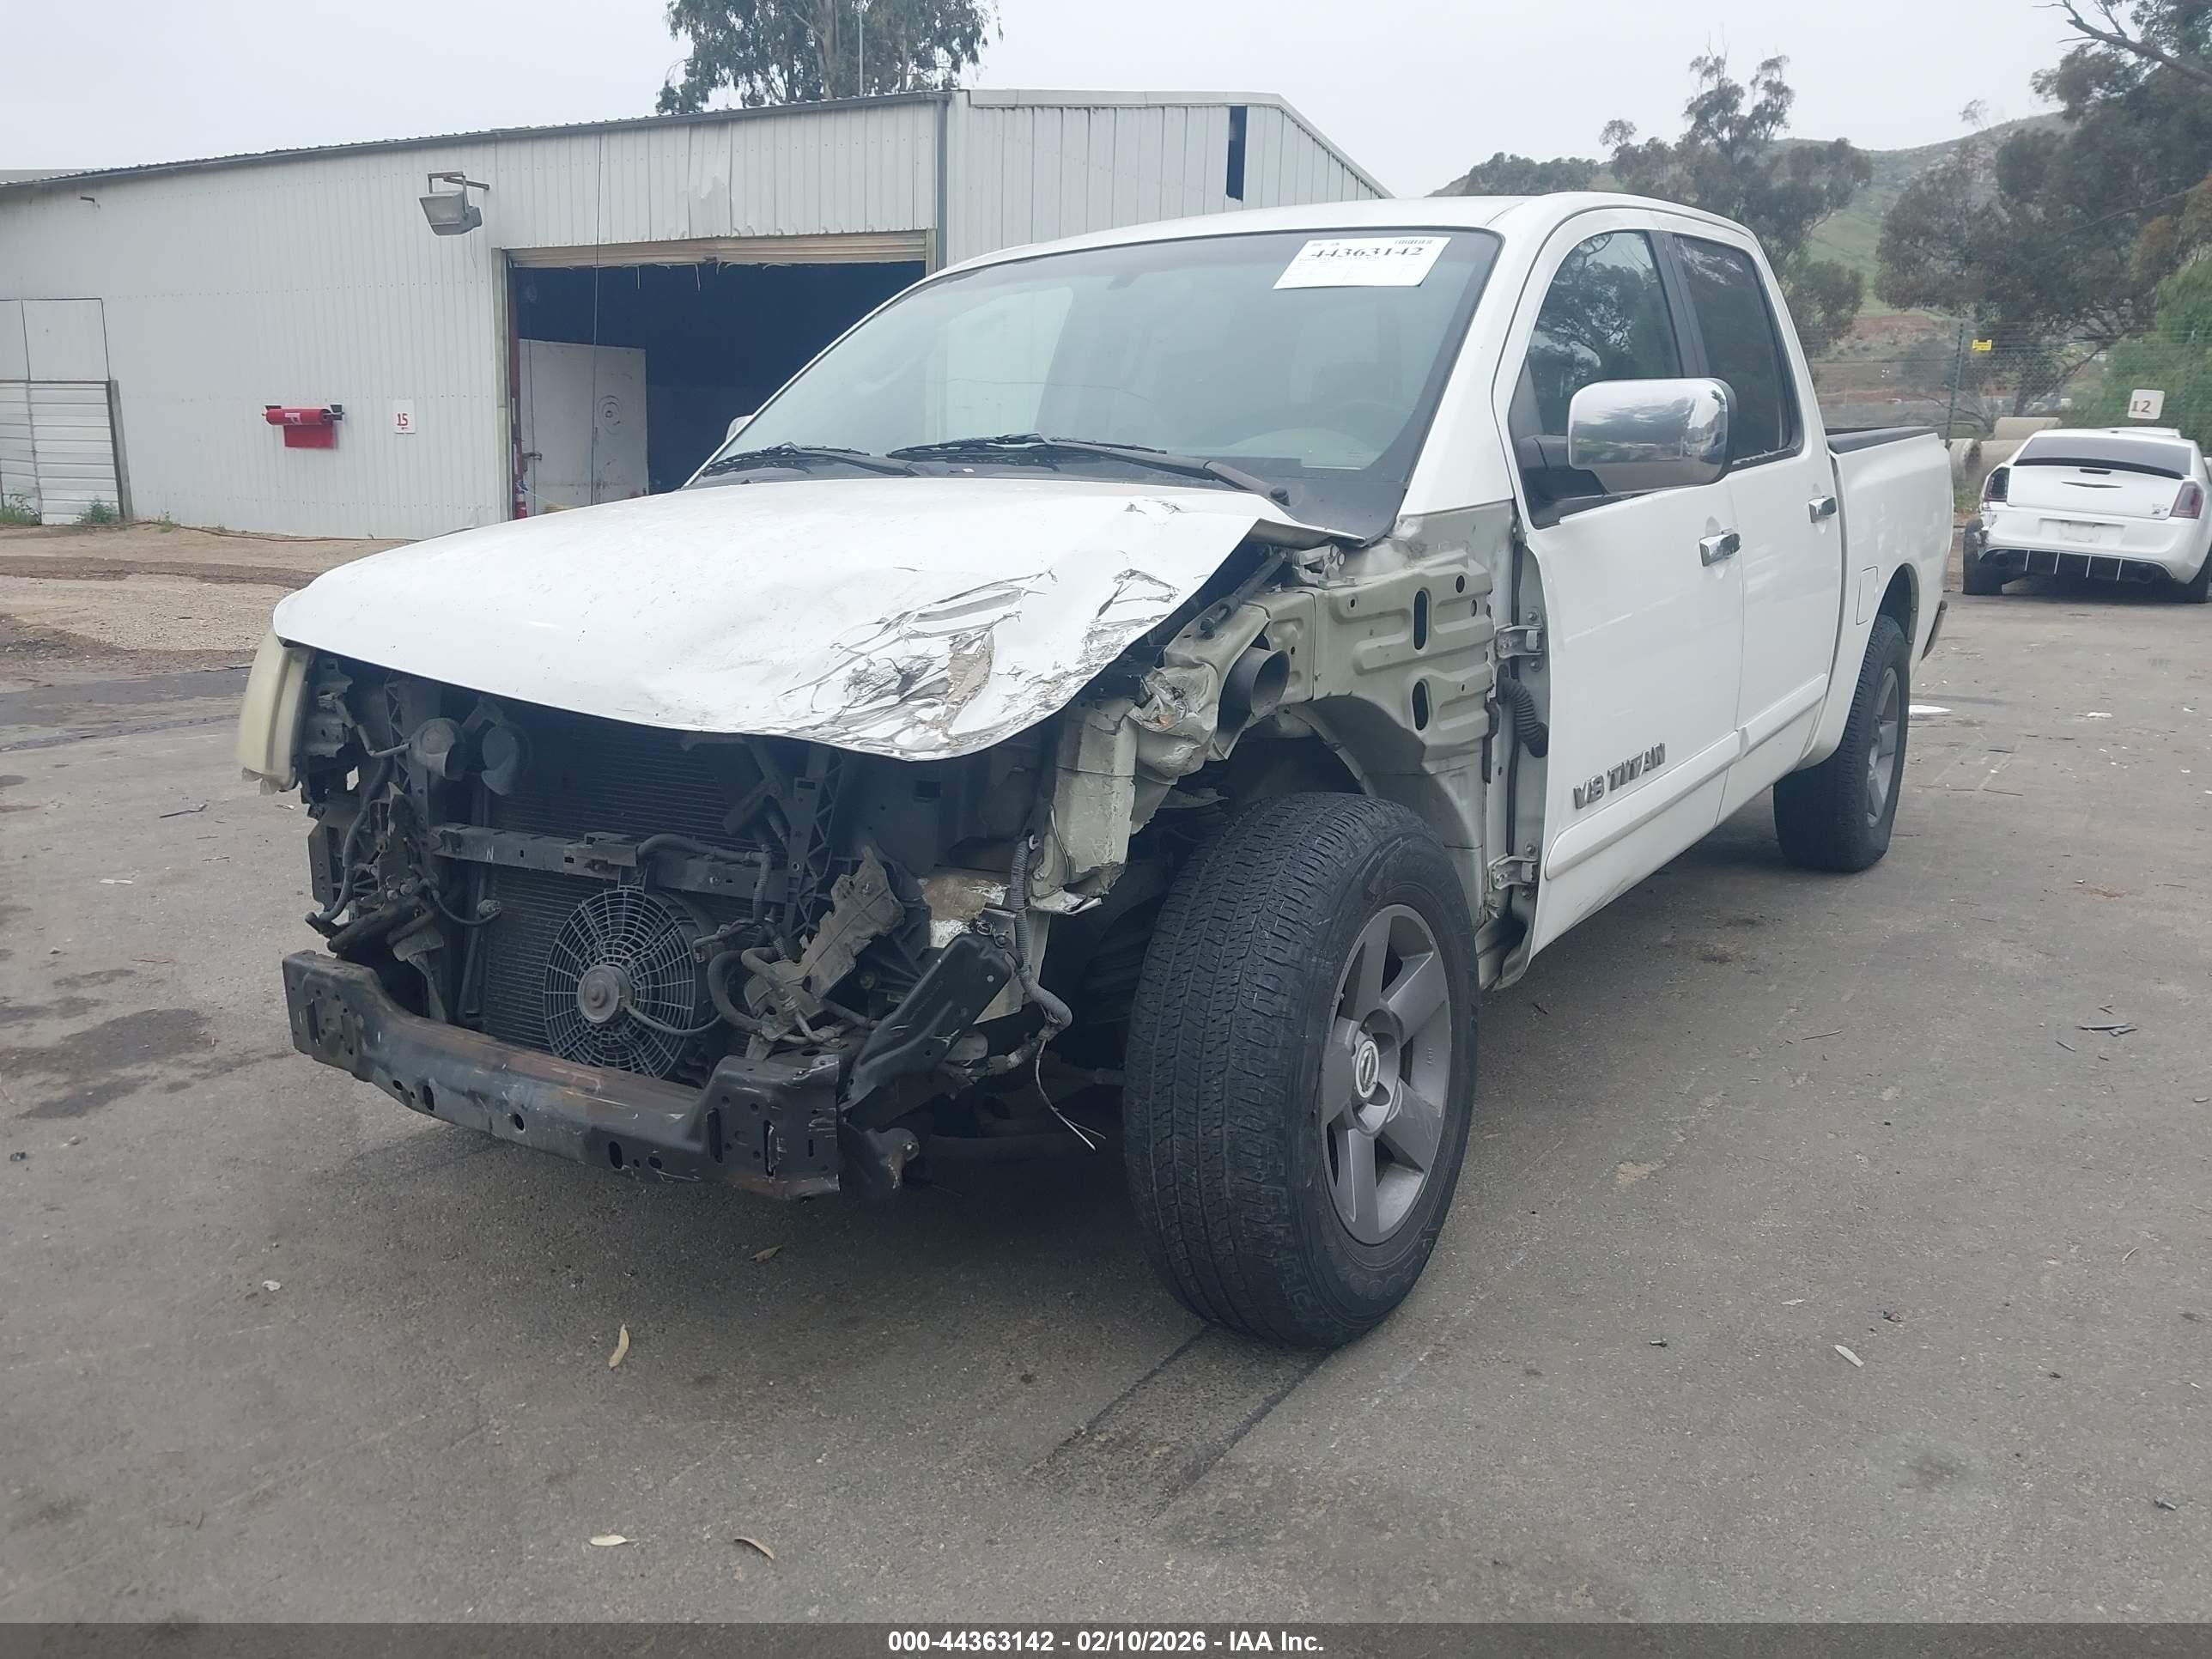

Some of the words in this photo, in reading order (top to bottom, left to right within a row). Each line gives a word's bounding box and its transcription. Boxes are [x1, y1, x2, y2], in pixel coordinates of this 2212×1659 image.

[1310, 246, 1425, 258] 44363142
[397, 412, 409, 426] 15
[1573, 774, 1605, 809] V8
[1607, 742, 1666, 791] TITAN
